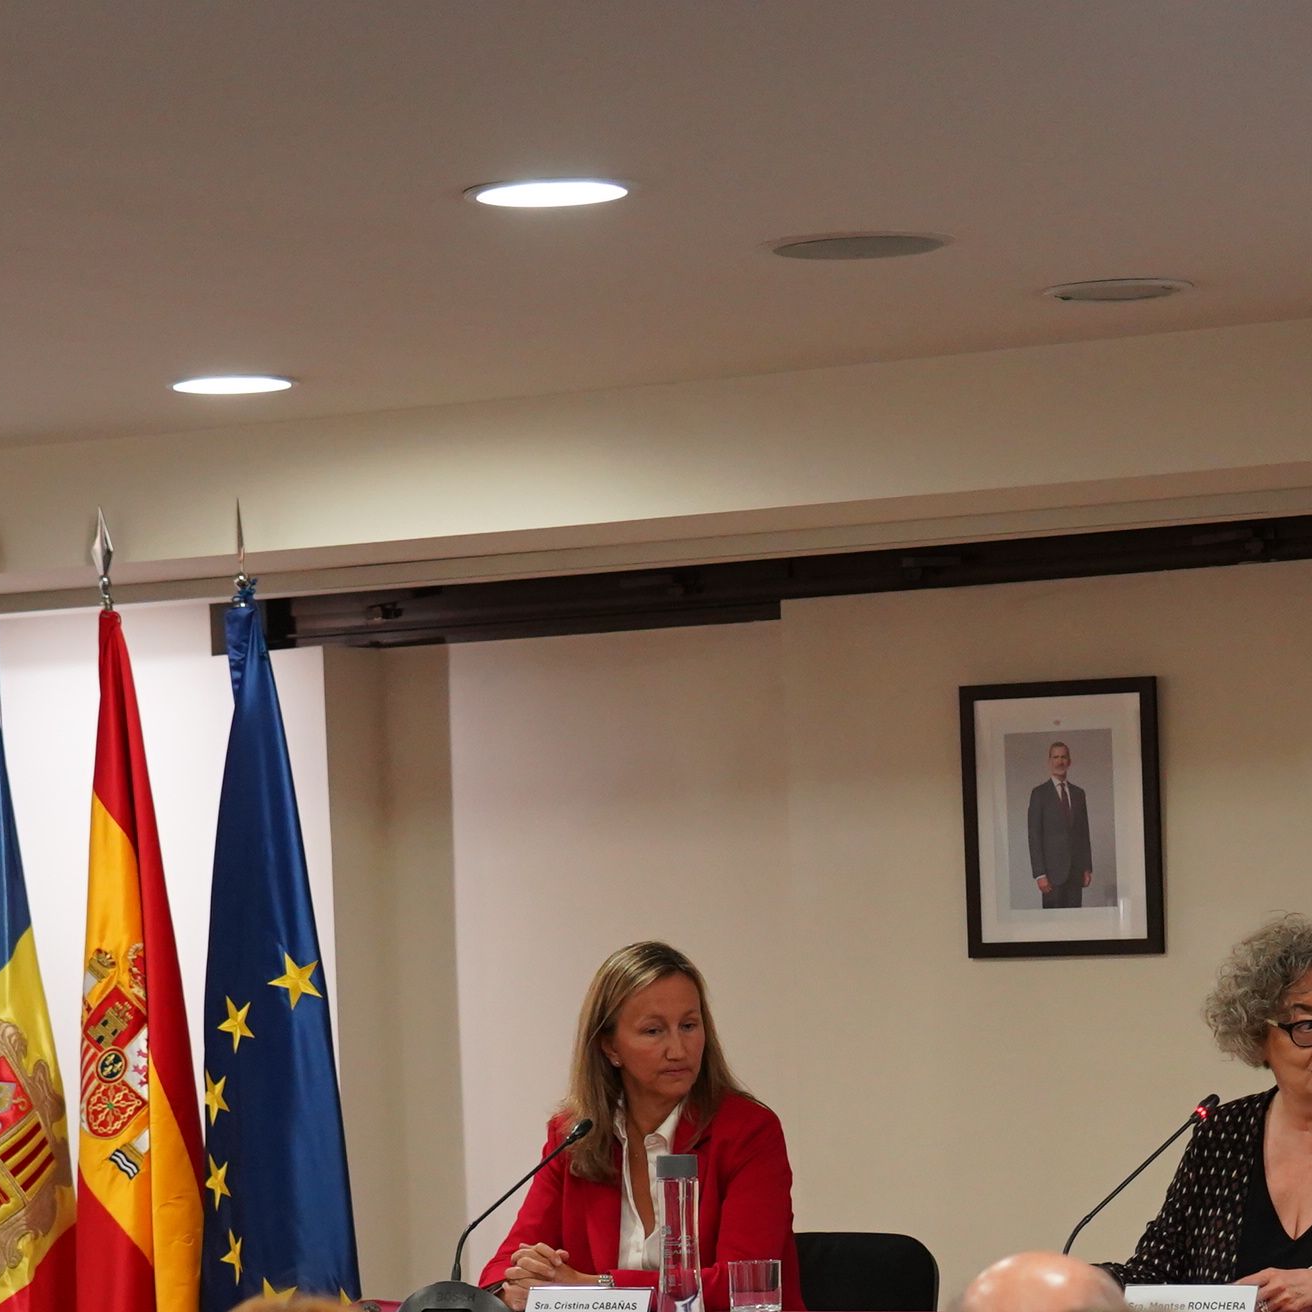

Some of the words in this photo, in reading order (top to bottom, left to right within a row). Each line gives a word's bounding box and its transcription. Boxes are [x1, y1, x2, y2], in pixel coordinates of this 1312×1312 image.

[534, 1301, 552, 1310] Sra.
[554, 1300, 590, 1310] Cristina
[592, 1299, 638, 1311] CABAÑAS
[1188, 1301, 1247, 1311] RONCHERA
